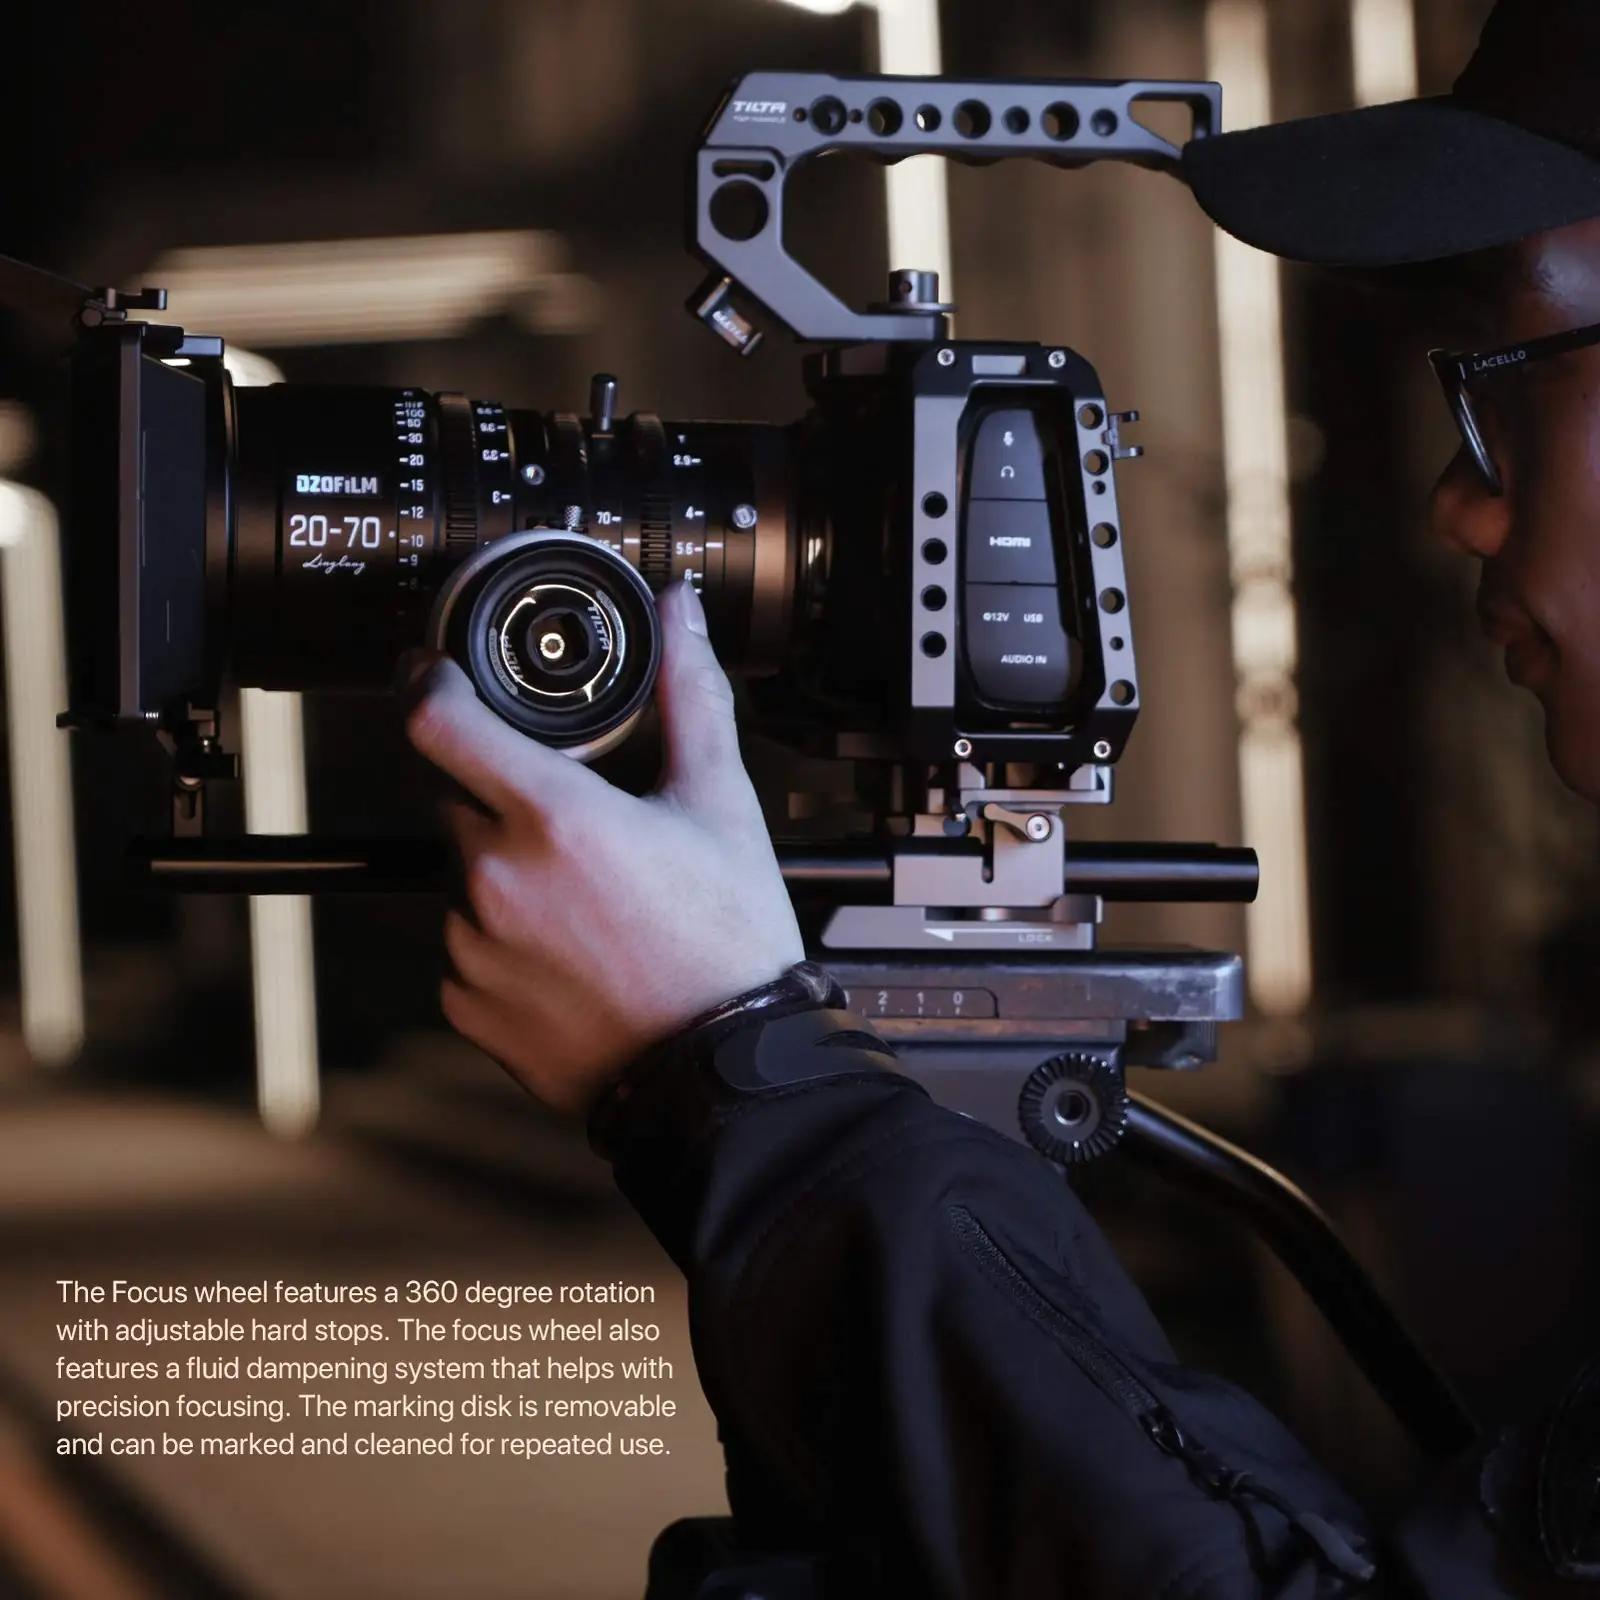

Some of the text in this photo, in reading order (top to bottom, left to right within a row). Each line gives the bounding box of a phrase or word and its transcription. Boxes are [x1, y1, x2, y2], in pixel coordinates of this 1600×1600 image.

[733, 100, 787, 113] TILTA
[1473, 350, 1526, 371] LACELLO
[407, 432, 423, 444] 30
[409, 453, 424, 466] 20
[411, 478, 424, 492] 15
[411, 505, 424, 520] 12
[596, 511, 611, 525] 70
[685, 505, 694, 520] 4
[289, 514, 381, 549] 20-70
[411, 533, 424, 548] 10
[675, 541, 693, 556] 5.6
[410, 553, 418, 566] 9
[1023, 612, 1044, 623] USB
[1000, 654, 1047, 665] AUDIO IN
[877, 990, 888, 1005] 2
